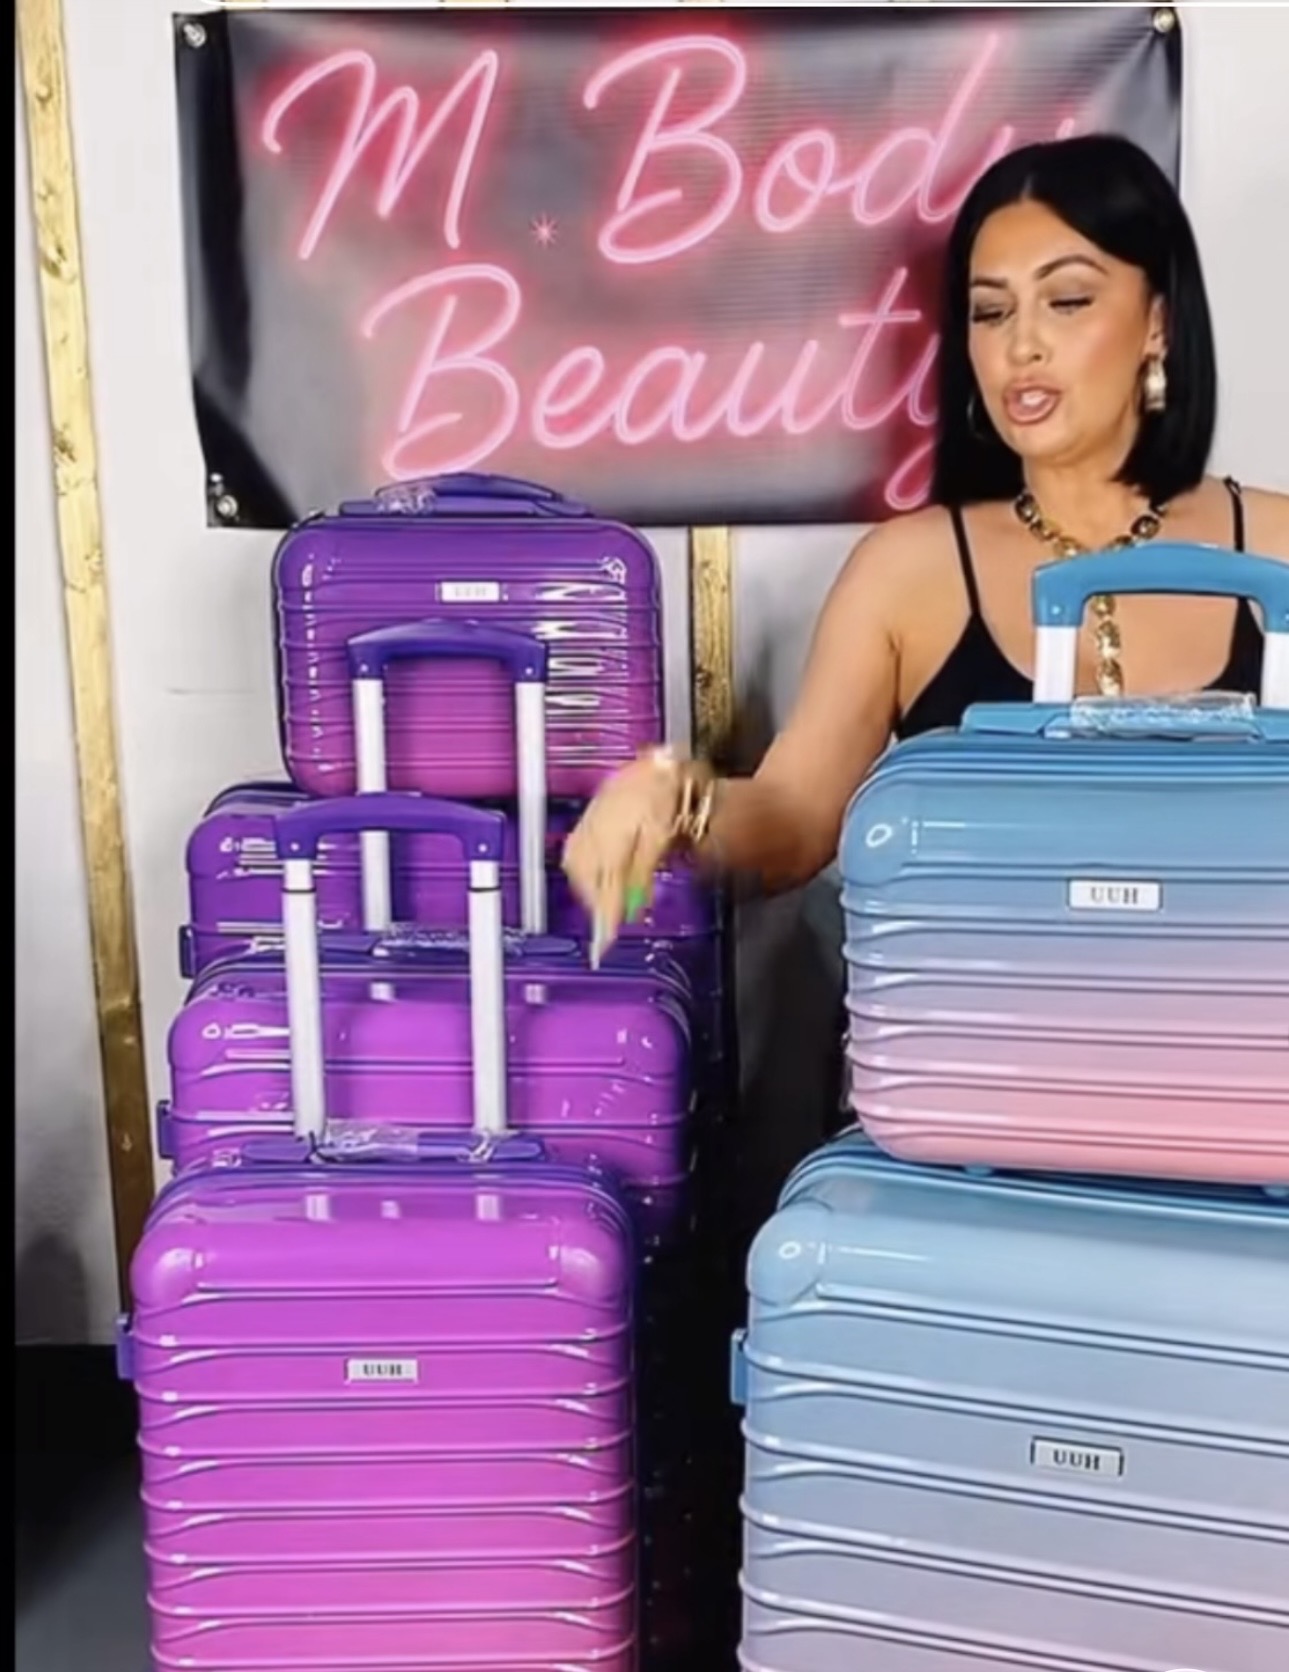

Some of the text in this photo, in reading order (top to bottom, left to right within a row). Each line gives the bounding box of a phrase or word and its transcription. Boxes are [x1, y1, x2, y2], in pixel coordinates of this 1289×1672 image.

[262, 31, 1076, 264] M Bod
[1091, 886, 1138, 905] UUH
[1053, 1449, 1100, 1471] UUH
